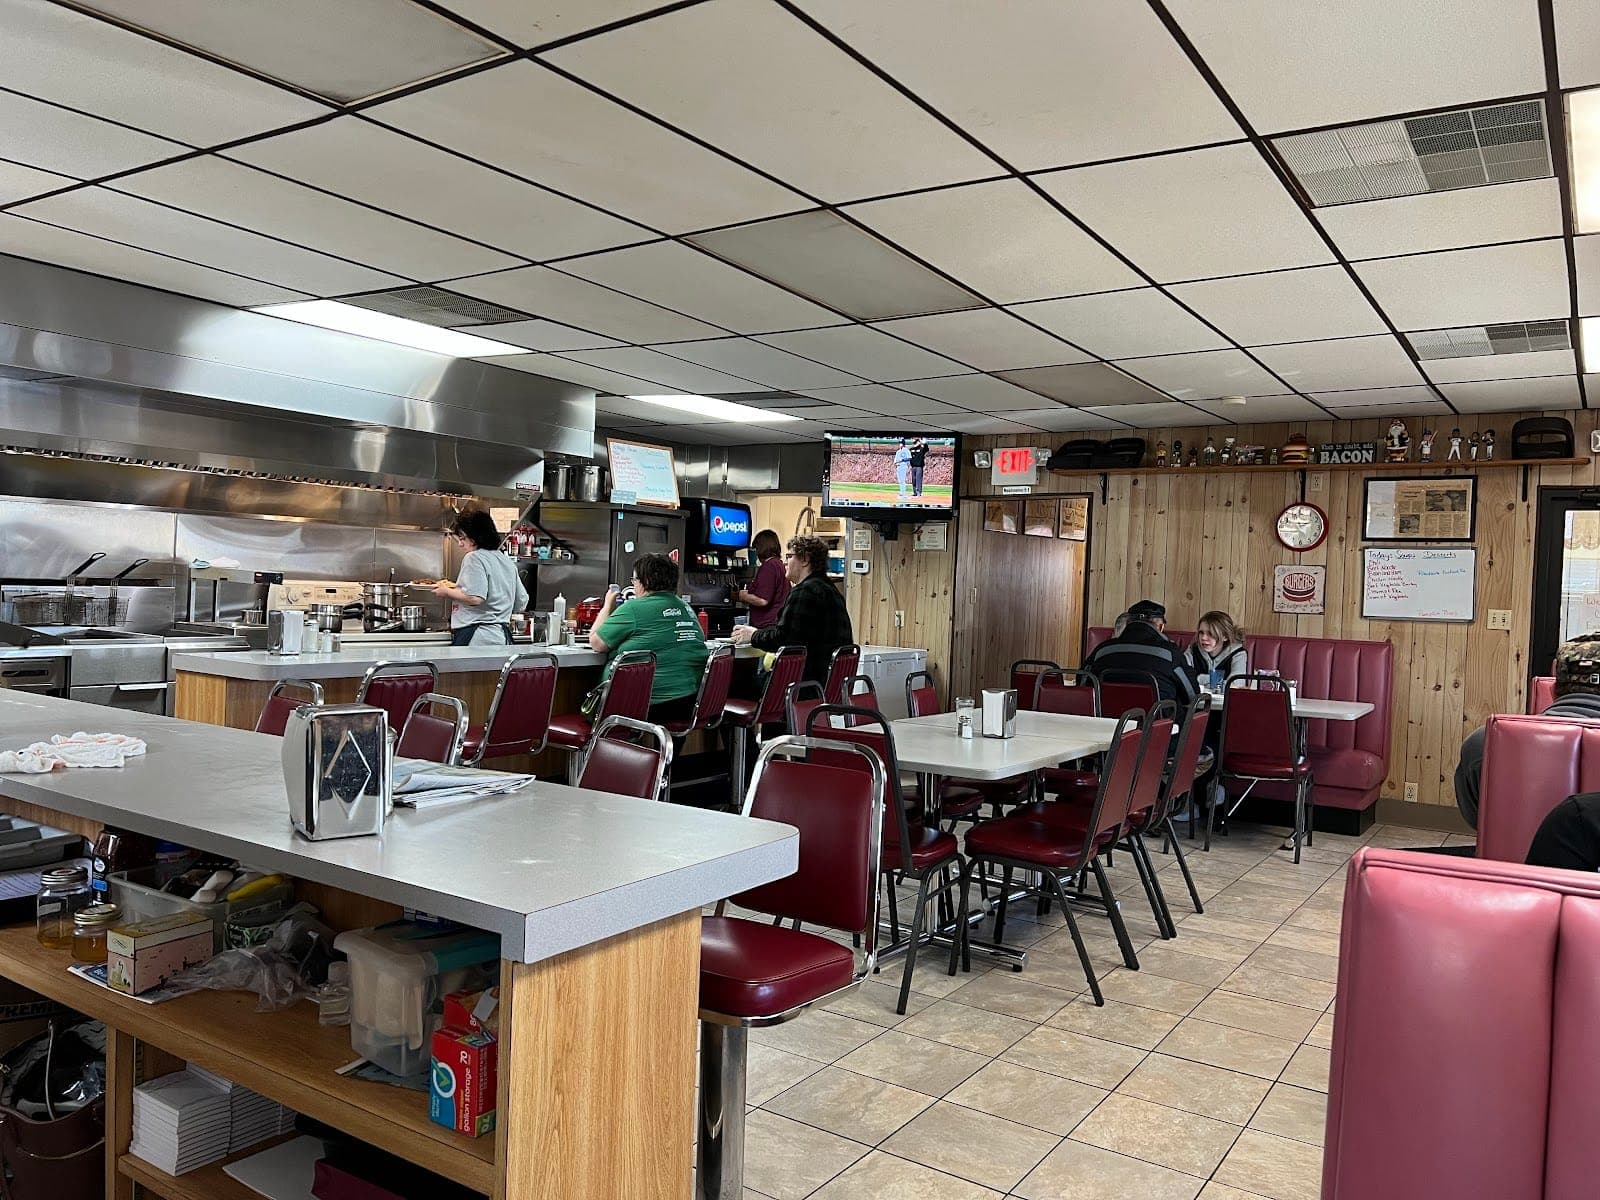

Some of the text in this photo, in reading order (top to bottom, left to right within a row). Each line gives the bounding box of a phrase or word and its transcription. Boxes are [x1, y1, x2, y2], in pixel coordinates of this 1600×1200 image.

[1001, 449, 1030, 473] EXIT
[1320, 450, 1374, 464] BACON
[723, 521, 747, 534] pepsi
[1285, 573, 1314, 590] BURGERS
[460, 1050, 468, 1064] 70
[464, 1067, 472, 1102] storage
